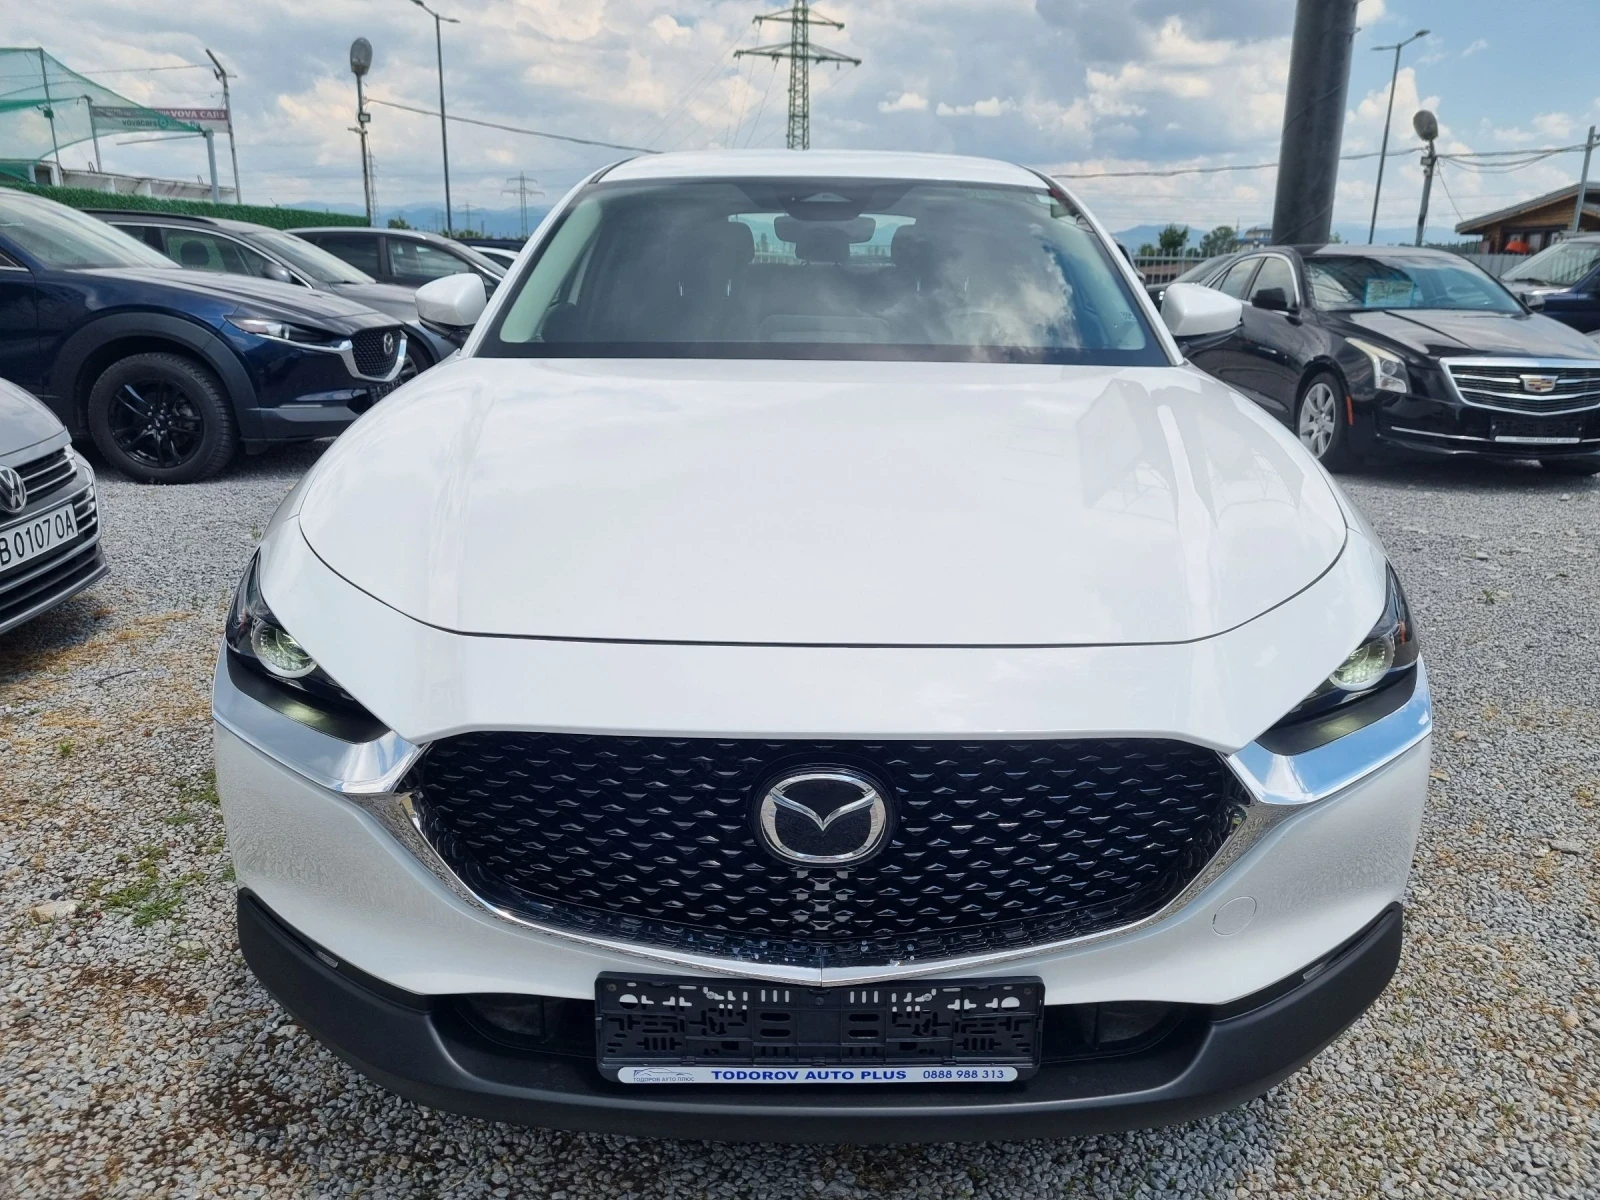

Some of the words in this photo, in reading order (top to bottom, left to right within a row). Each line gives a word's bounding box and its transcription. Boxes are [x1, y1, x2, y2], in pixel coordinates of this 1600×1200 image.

[170, 109, 198, 118] VOVA
[711, 1070, 799, 1080] TODOROV
[804, 1070, 855, 1080] AUTO
[860, 1070, 907, 1080] PLUS
[922, 1069, 952, 1079] 0888
[956, 1069, 978, 1079] 988
[982, 1069, 1005, 1079] 313
